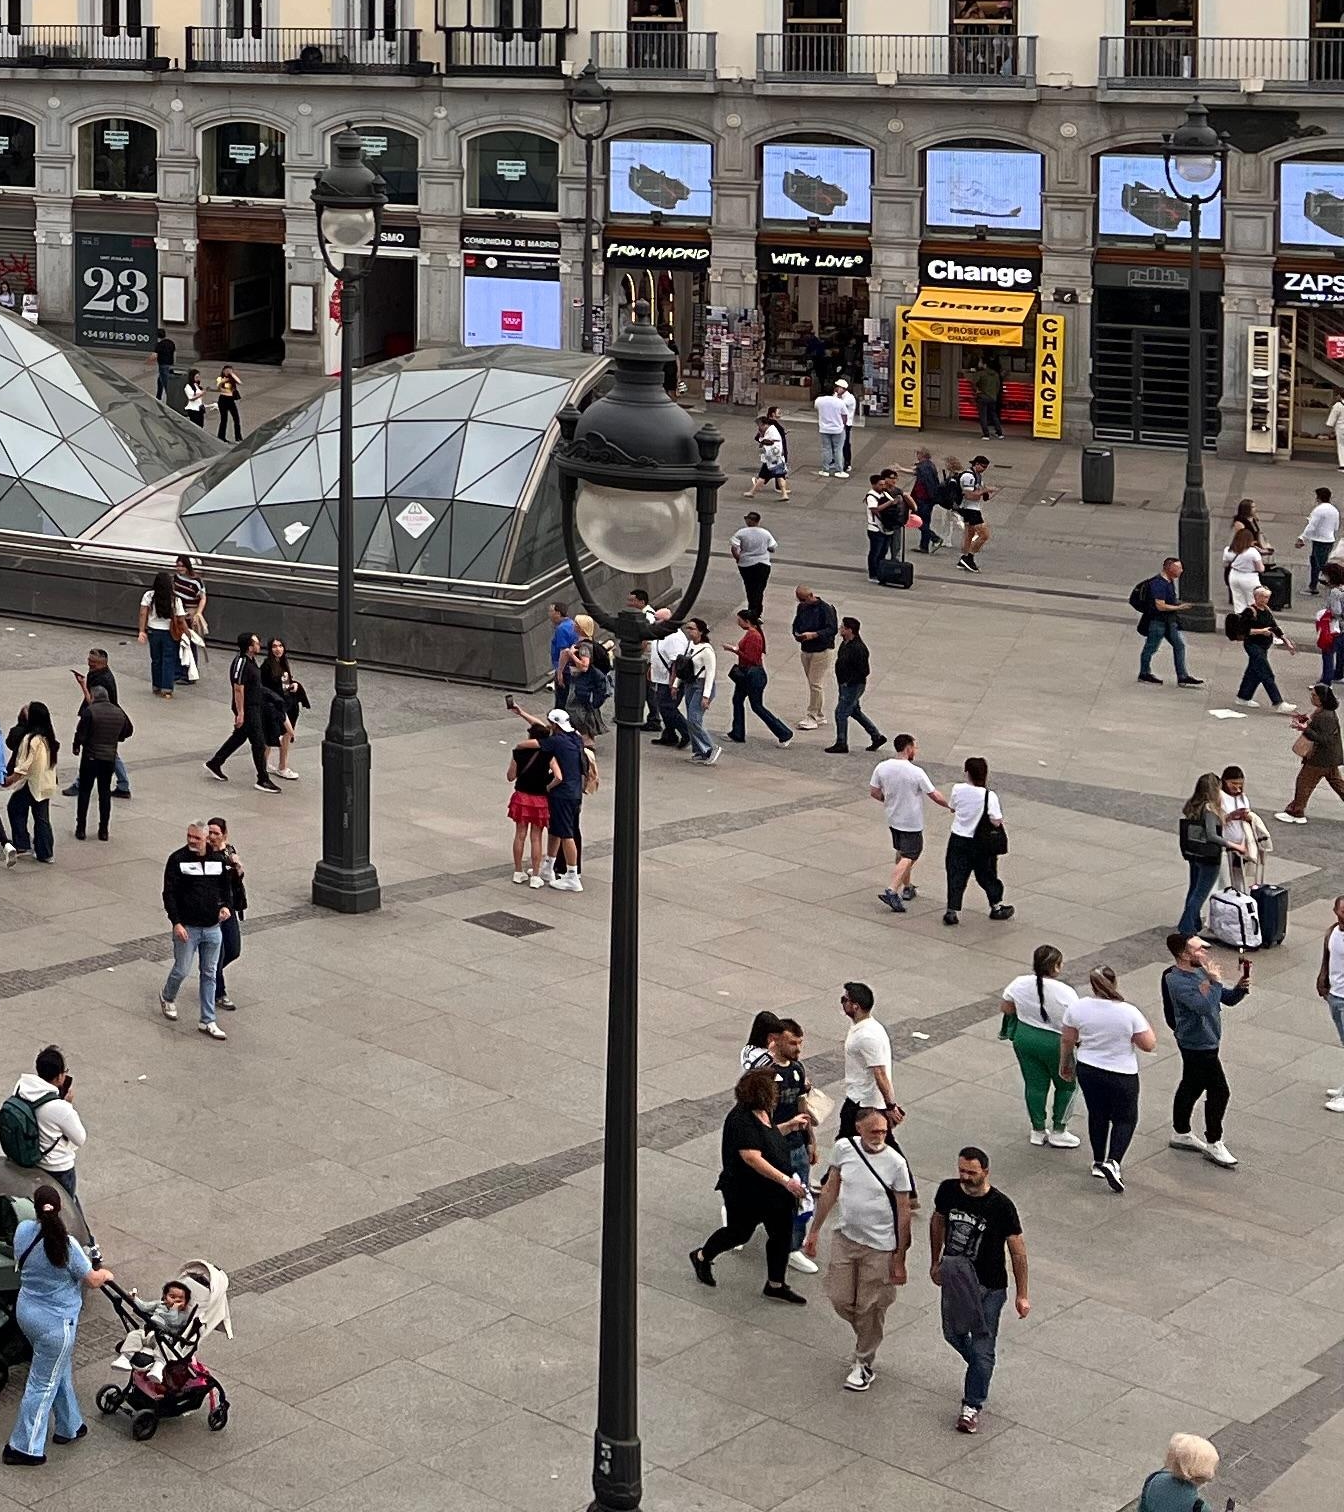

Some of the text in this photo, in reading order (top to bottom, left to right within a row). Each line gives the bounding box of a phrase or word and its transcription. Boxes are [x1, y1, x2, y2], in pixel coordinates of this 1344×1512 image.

[464, 237, 560, 249] COMUNIDAD DE MADRID
[606, 243, 709, 260] FROM MADRID
[771, 252, 810, 267] WITH
[927, 259, 1033, 287] Change
[83, 266, 150, 314] 23
[1063, 293, 1072, 303] 6
[920, 300, 1025, 313] Change
[82, 330, 98, 338] +34
[98, 331, 108, 339] 91
[947, 326, 1001, 337] PROSEGUR
[1040, 318, 1058, 419] CHANGE
